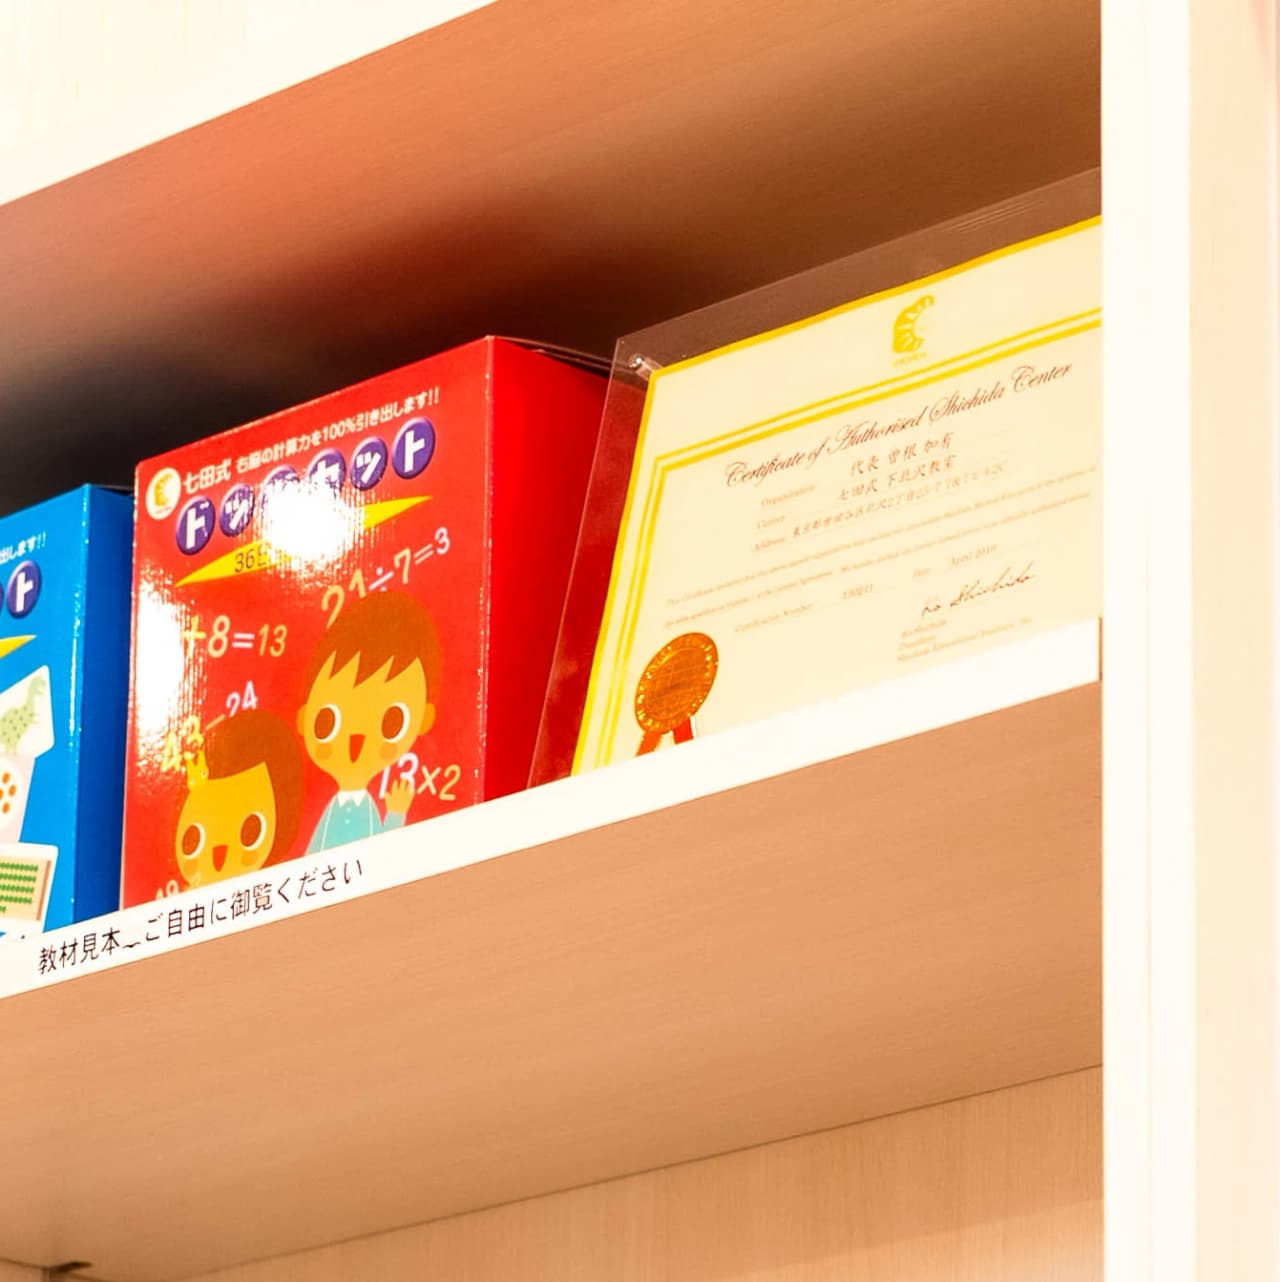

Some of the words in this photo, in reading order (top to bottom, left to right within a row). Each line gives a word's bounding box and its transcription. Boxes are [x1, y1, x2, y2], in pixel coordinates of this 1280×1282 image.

[184, 458, 232, 494] 七田式
[725, 450, 806, 488] Certificate
[807, 438, 830, 470] of
[827, 407, 928, 456] Authorised
[928, 385, 1007, 424] Shichida
[1011, 363, 1072, 393] Center
[37, 926, 122, 976] 教材見本
[144, 859, 363, 943] ご自由に御覧ください
